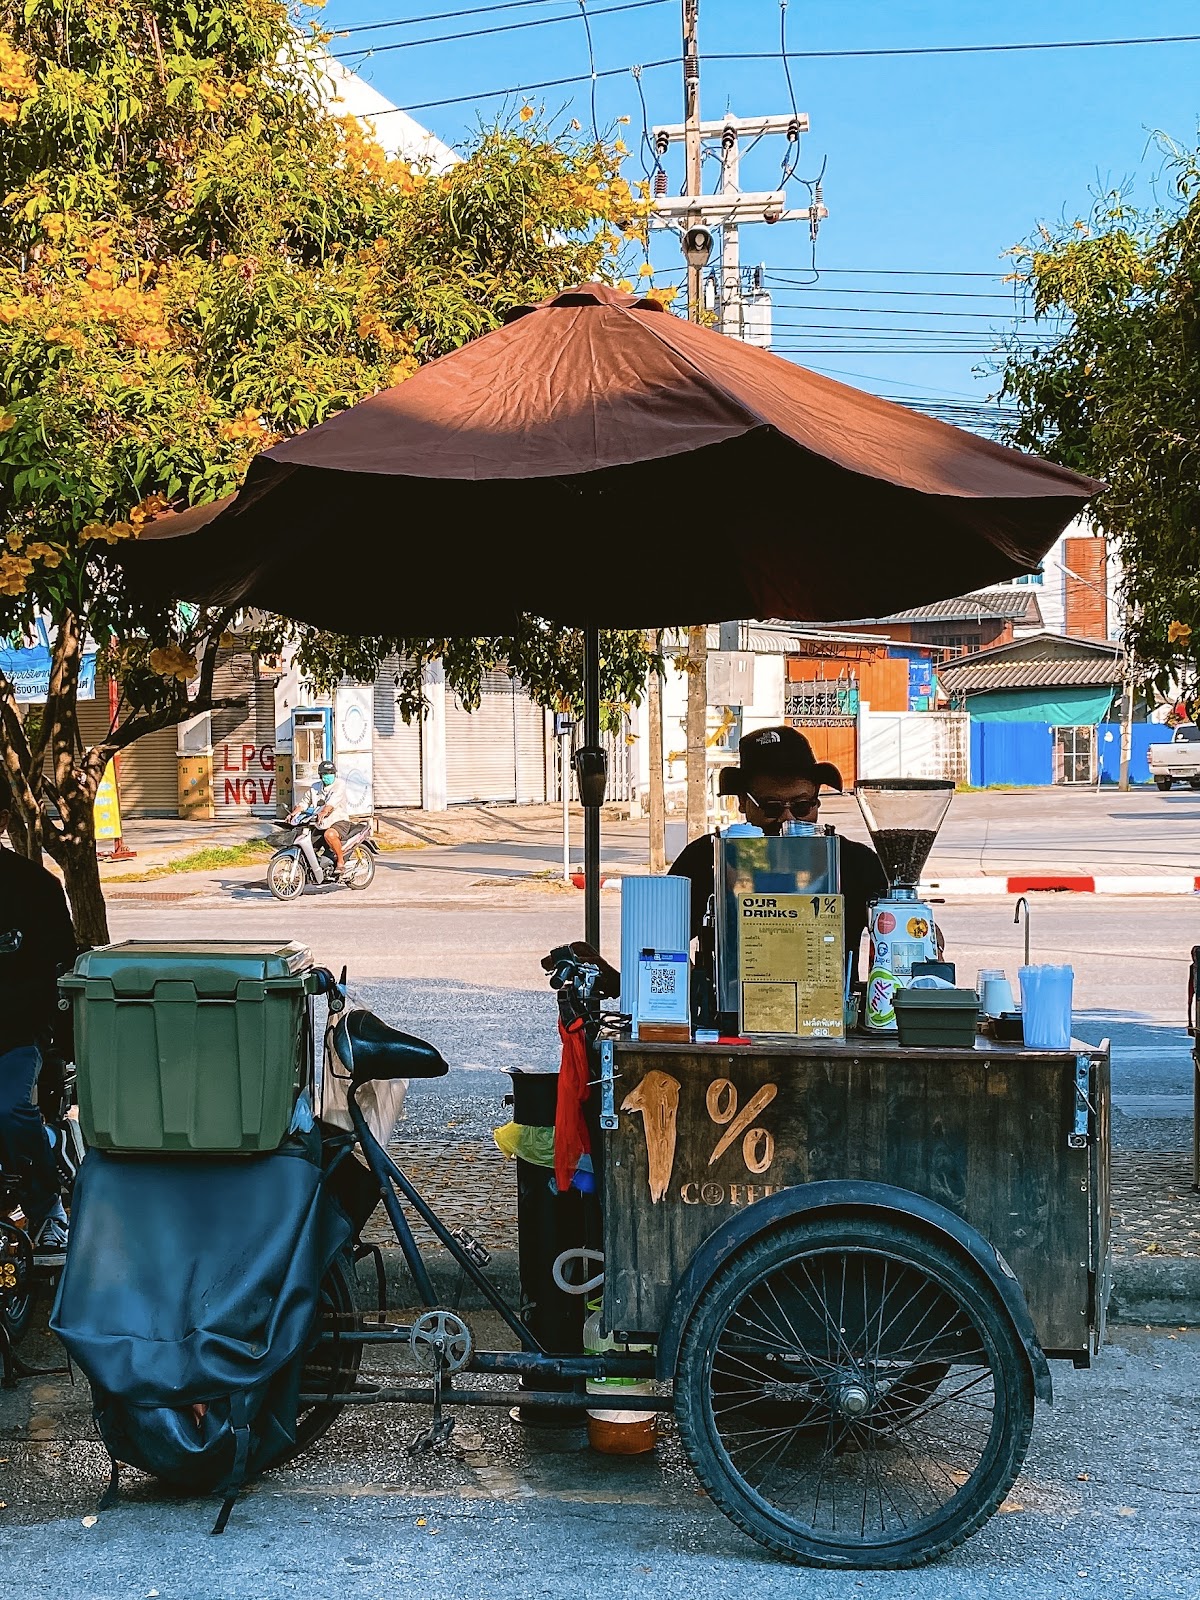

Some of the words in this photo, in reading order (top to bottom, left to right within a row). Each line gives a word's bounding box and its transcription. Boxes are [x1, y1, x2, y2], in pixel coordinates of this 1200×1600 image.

[224, 745, 275, 771] LPG
[224, 778, 275, 804] NGV
[743, 898, 777, 908] OUR
[743, 909, 798, 918] DRINKS
[809, 896, 837, 919] 1%
[620, 1069, 778, 1204] 1%
